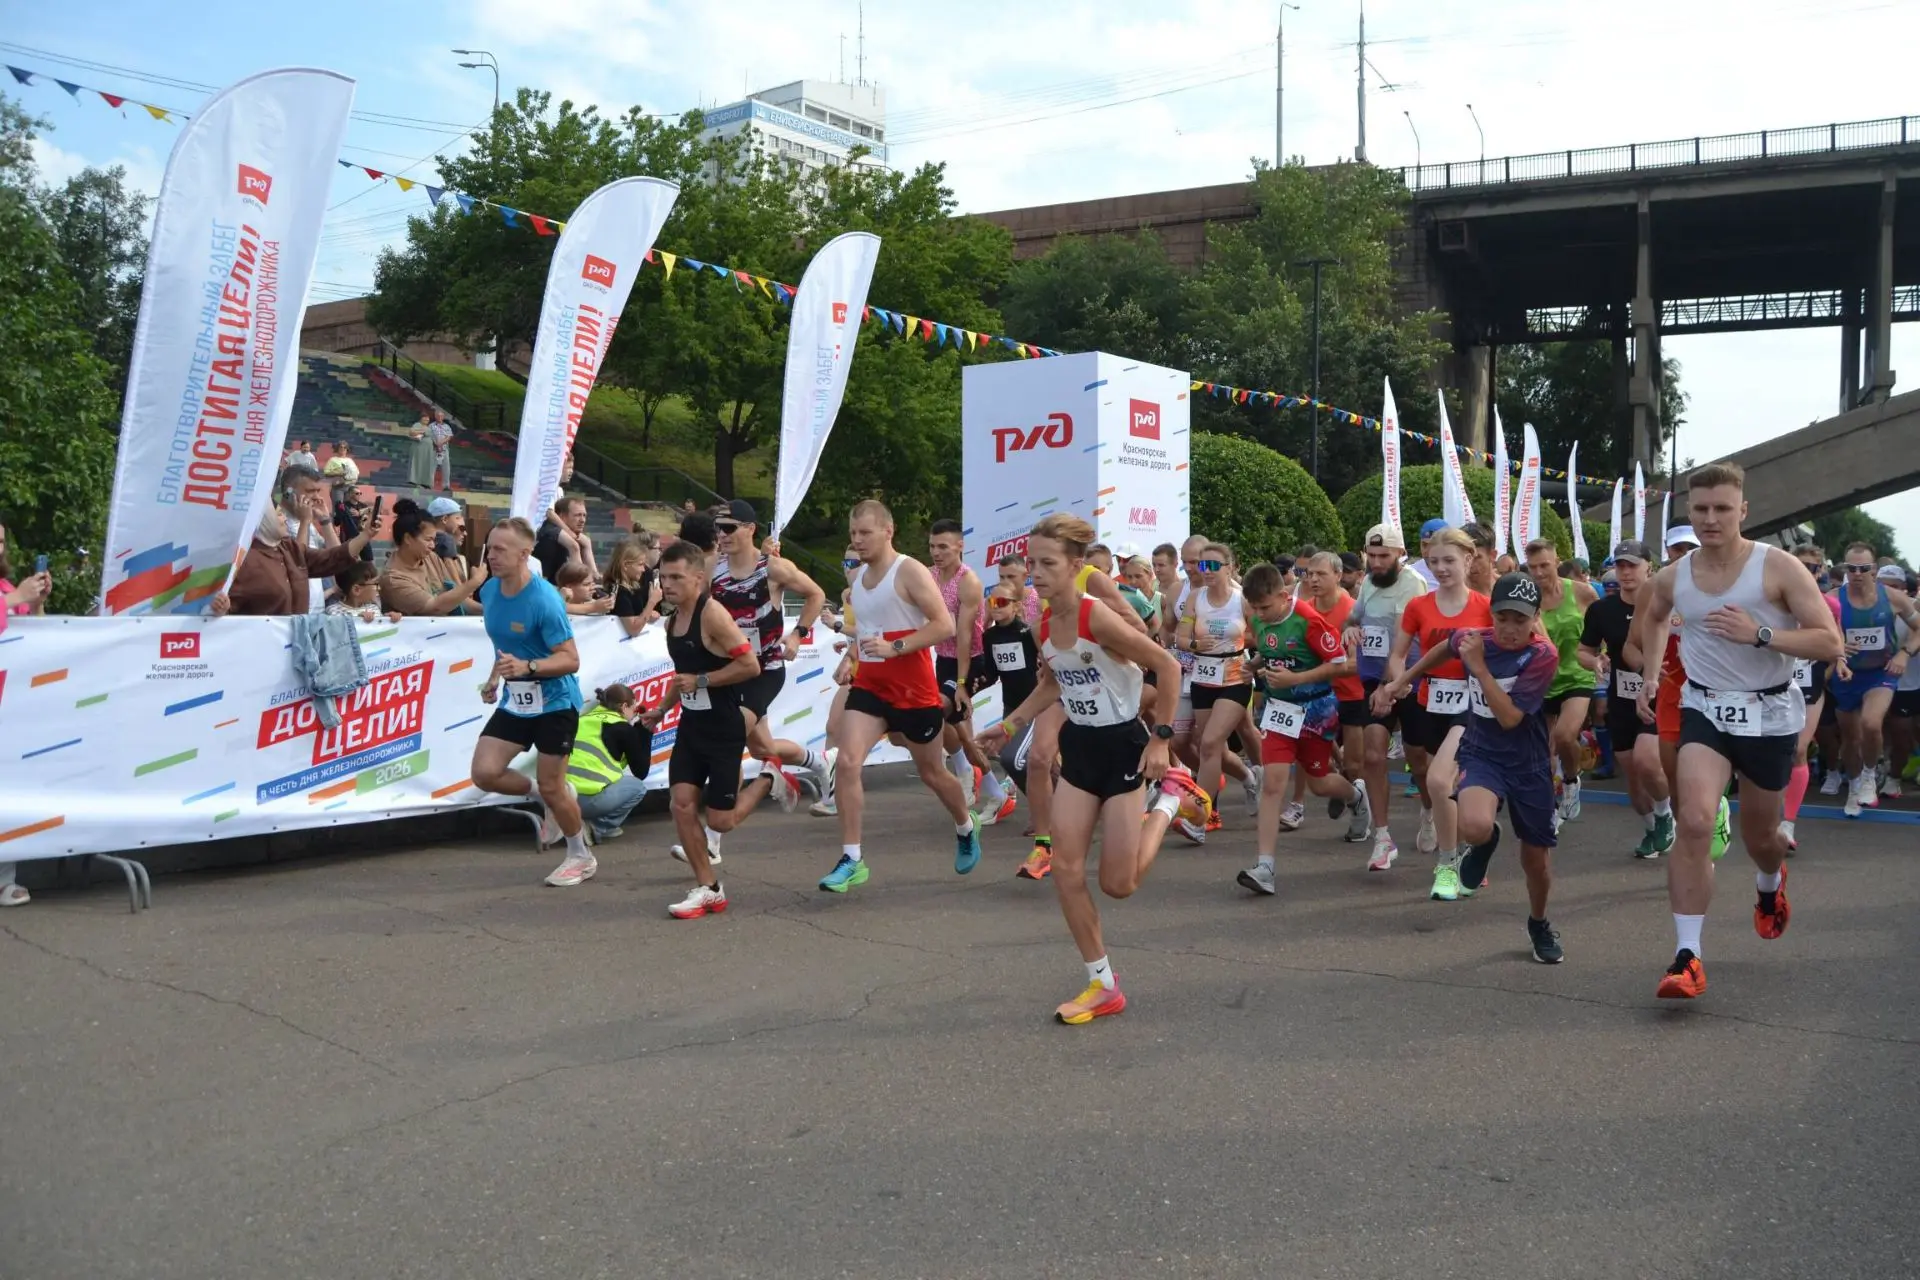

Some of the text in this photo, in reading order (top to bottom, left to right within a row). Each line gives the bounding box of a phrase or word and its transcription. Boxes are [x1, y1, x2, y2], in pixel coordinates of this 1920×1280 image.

[248, 240, 280, 408] ЖЕЛЕЗНОДОРОЖНИКА
[570, 304, 604, 391] ЦЕЛИ!
[157, 218, 236, 505] БЛАГОТВОРИТЕЛЬНЫЙ ЗАБЕГ
[182, 224, 261, 511] ДОСТИГАЯ ЦЕЛИ!
[244, 410, 265, 444] ДНЯ
[992, 412, 1073, 463] РЖД
[1123, 442, 1167, 459] Красноярская
[235, 448, 261, 496] ЧЕСТЬ
[1118, 456, 1171, 471] железная дорога
[232, 501, 250, 512] В
[393, 651, 423, 668] ЗАБЕГ
[996, 652, 1017, 663] 998
[145, 671, 214, 680] железная дорога
[151, 663, 208, 672] Красноярская
[1197, 665, 1217, 677] 543
[1435, 690, 1464, 704] 977
[1068, 698, 1099, 715] 883
[1714, 705, 1748, 723] 121
[1269, 710, 1294, 727] 286
[320, 700, 418, 757] ЦЕЛИ!
[260, 740, 414, 799] В ЧЕСТЬ ДНЯ ЖЕЛЕЗНОДОРОЖНИКА
[375, 761, 411, 785] 2026
